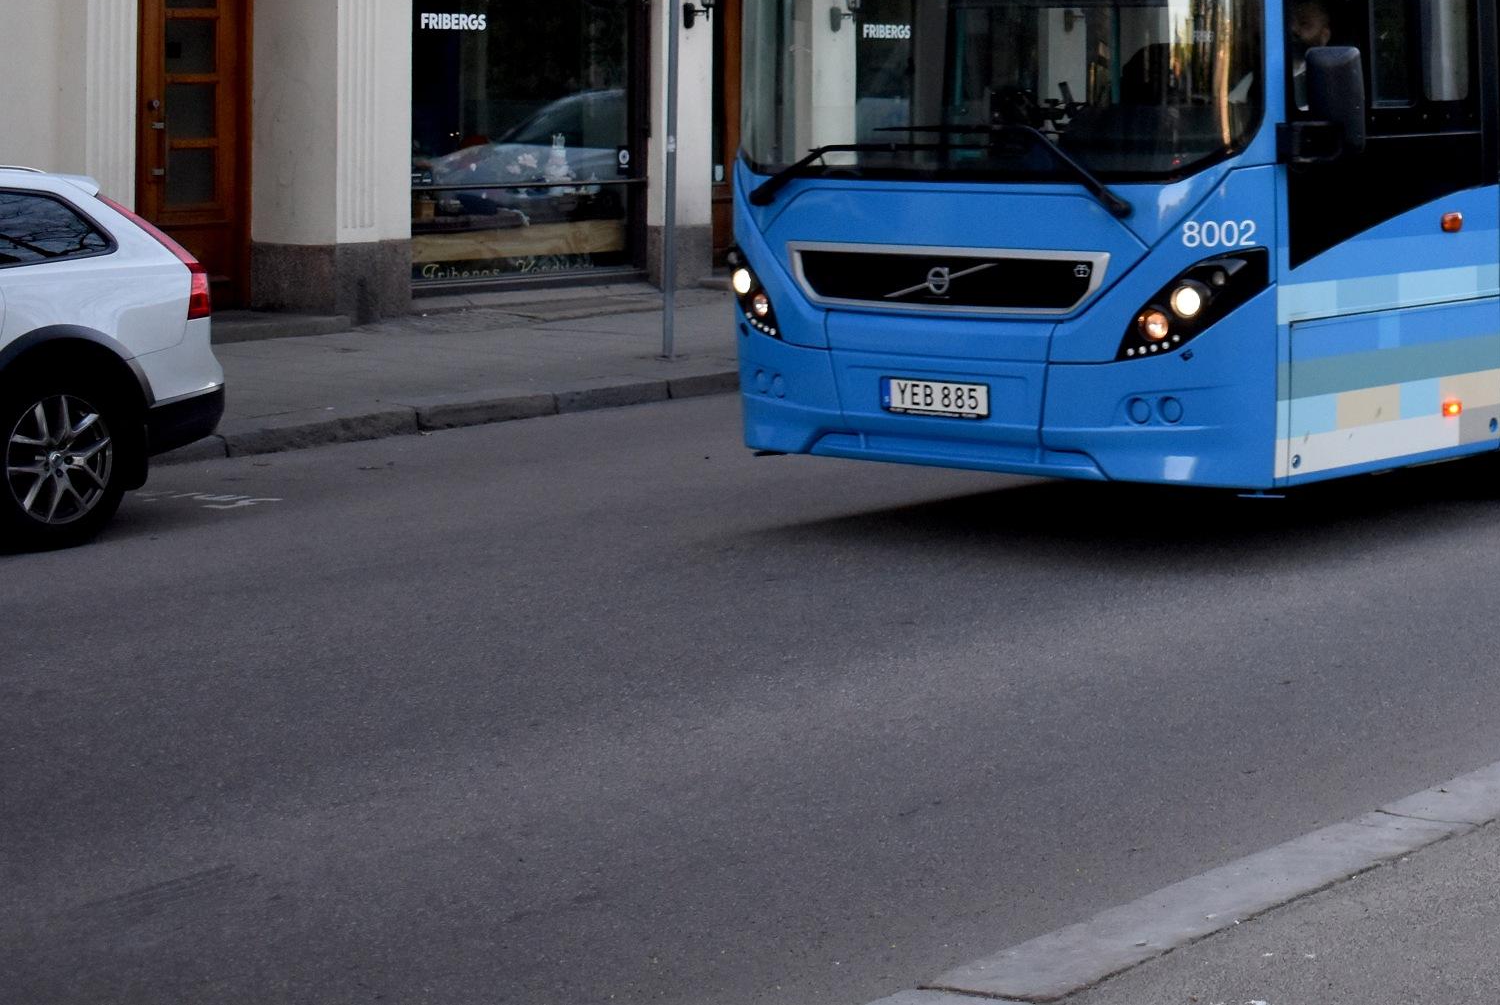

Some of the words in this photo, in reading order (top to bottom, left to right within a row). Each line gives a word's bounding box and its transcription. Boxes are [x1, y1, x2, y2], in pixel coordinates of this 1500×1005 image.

[421, 13, 487, 30] FRIBERGS
[863, 24, 912, 39] FRIBERGS
[1182, 219, 1256, 248] 8002
[898, 382, 934, 407] YEB
[941, 386, 979, 410] 885
